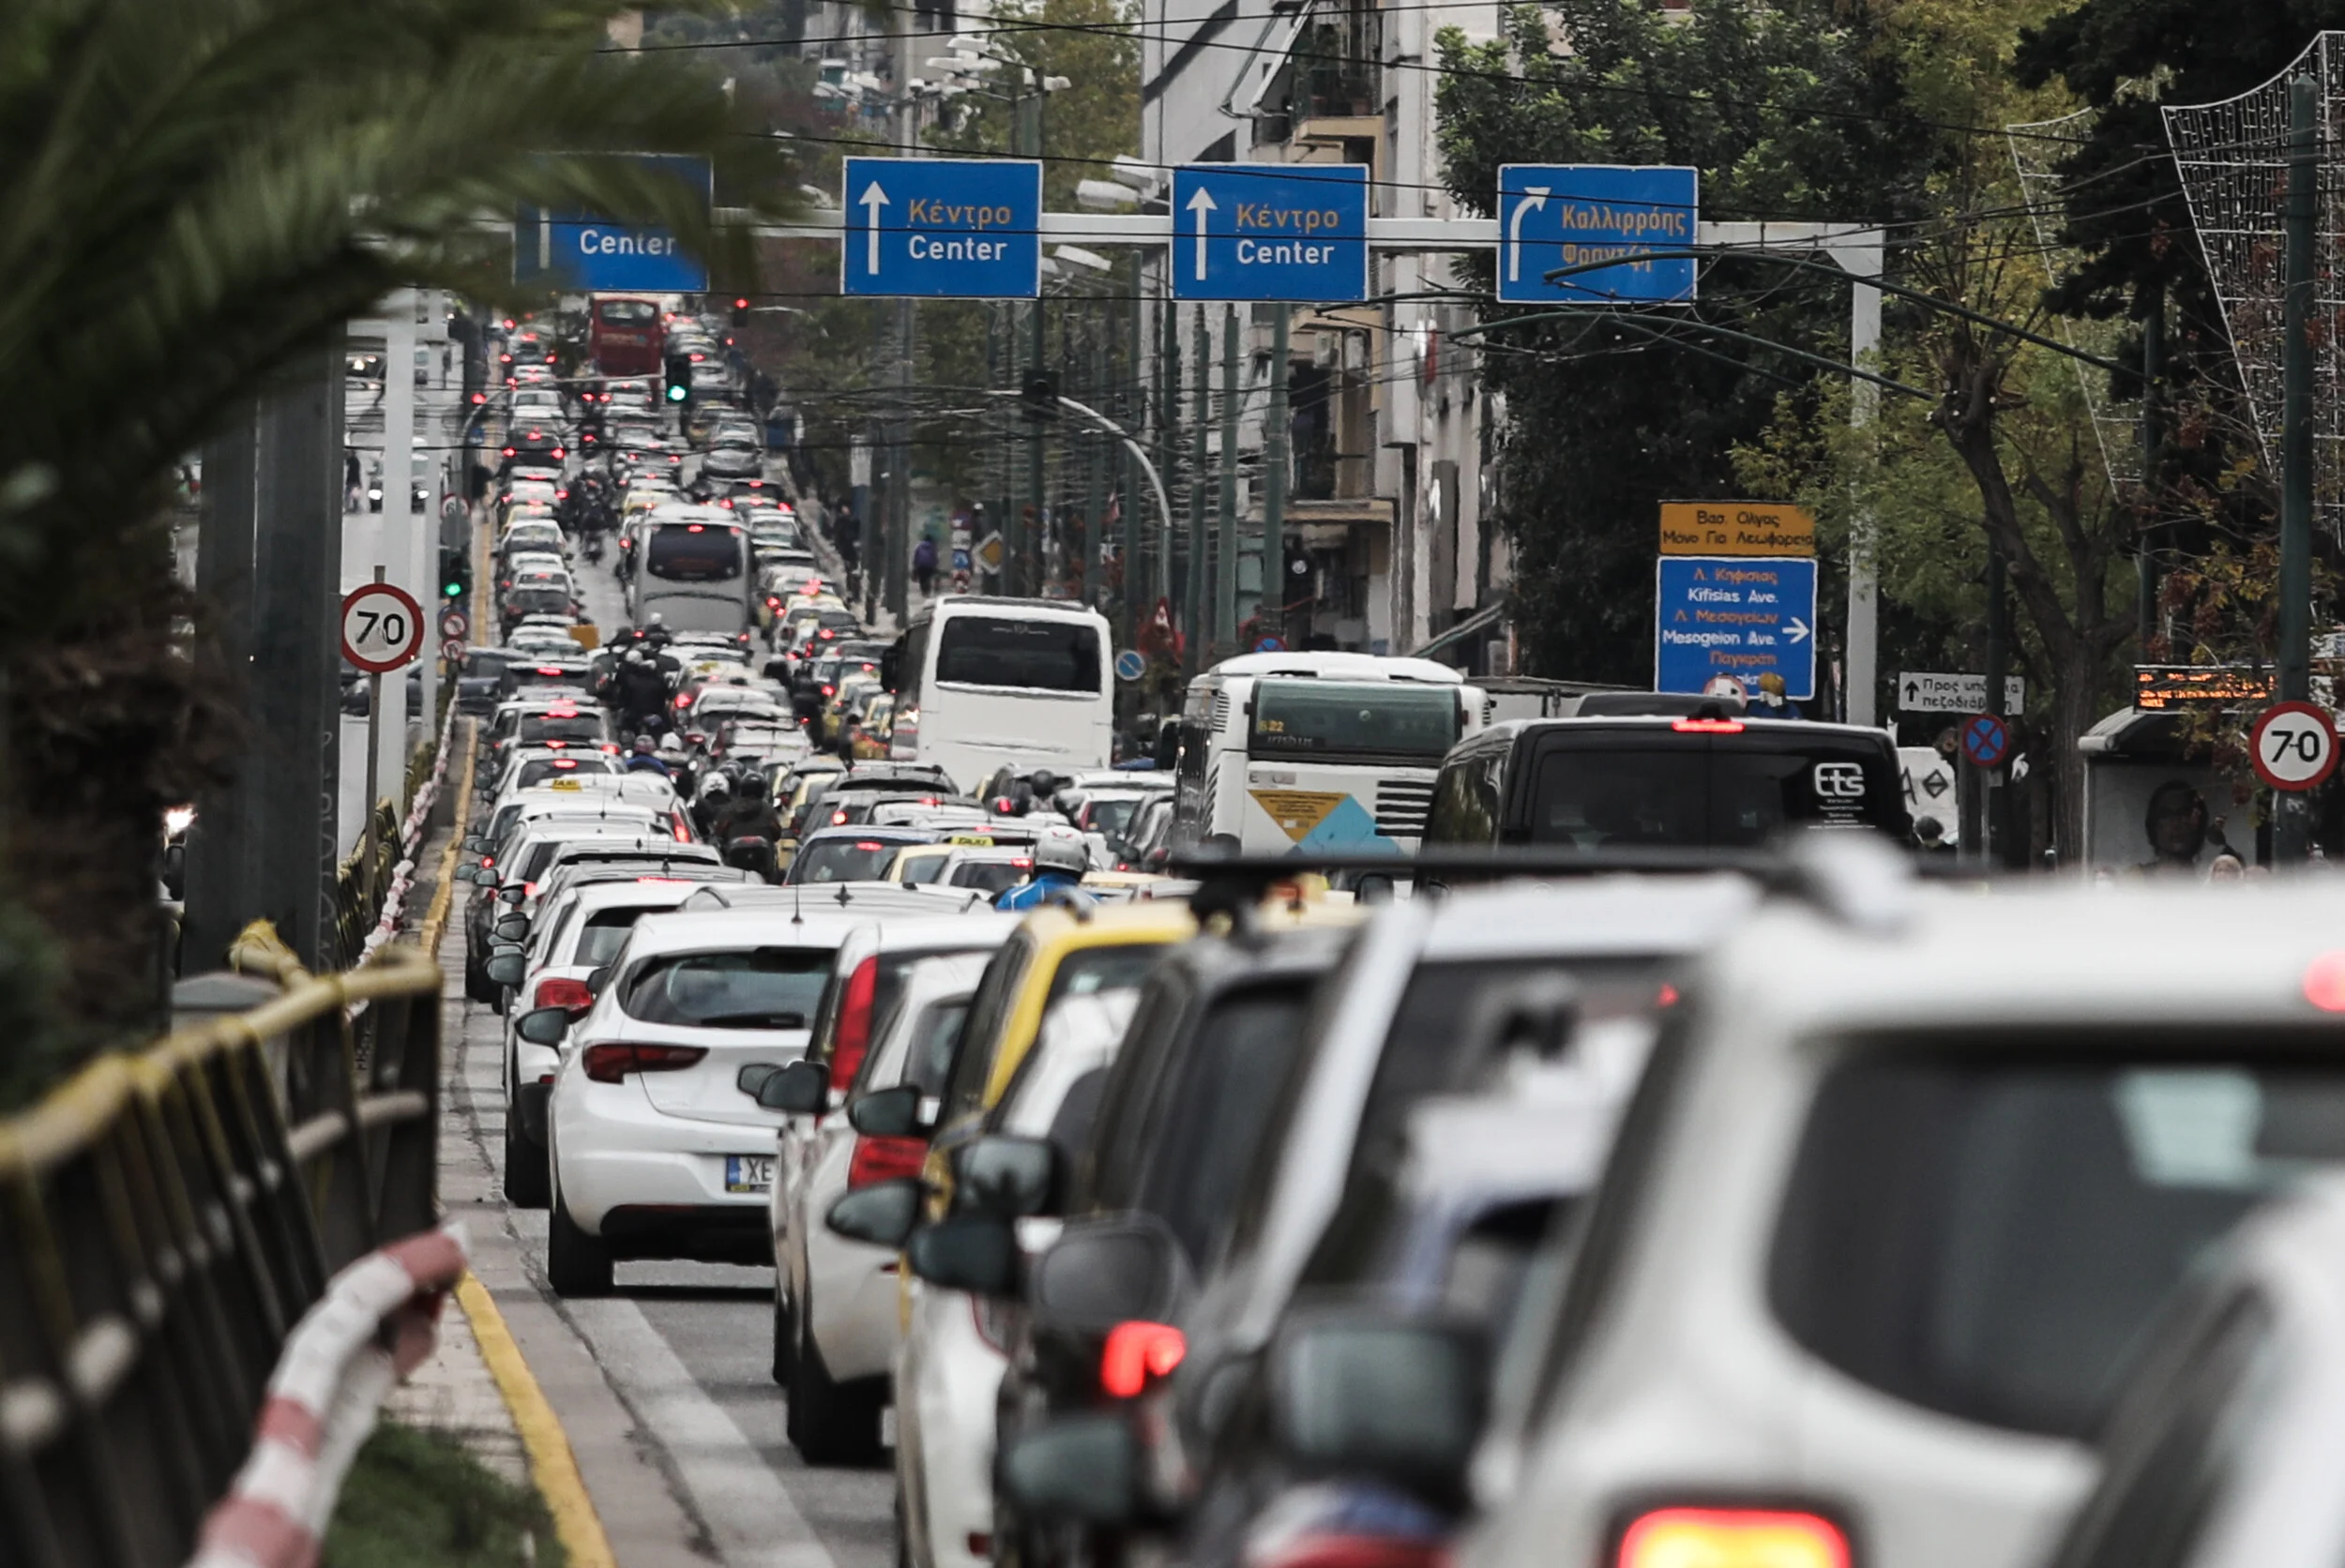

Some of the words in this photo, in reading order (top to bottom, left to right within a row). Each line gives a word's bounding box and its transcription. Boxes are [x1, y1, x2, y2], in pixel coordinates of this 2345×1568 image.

[909, 198, 1011, 231] Κέντρο
[1237, 203, 1339, 234] Κέντρο
[1563, 204, 1687, 236] Καλλιρρόης
[580, 229, 675, 255] Center
[909, 234, 1008, 261] Center
[1237, 239, 1335, 264] Center
[1688, 587, 1741, 603] Kifisias
[1747, 589, 1779, 603] Ave.
[356, 611, 405, 646] 70
[1662, 629, 1741, 648] Mesogeion
[1747, 630, 1778, 645] Ave.
[2271, 730, 2320, 762] 70
